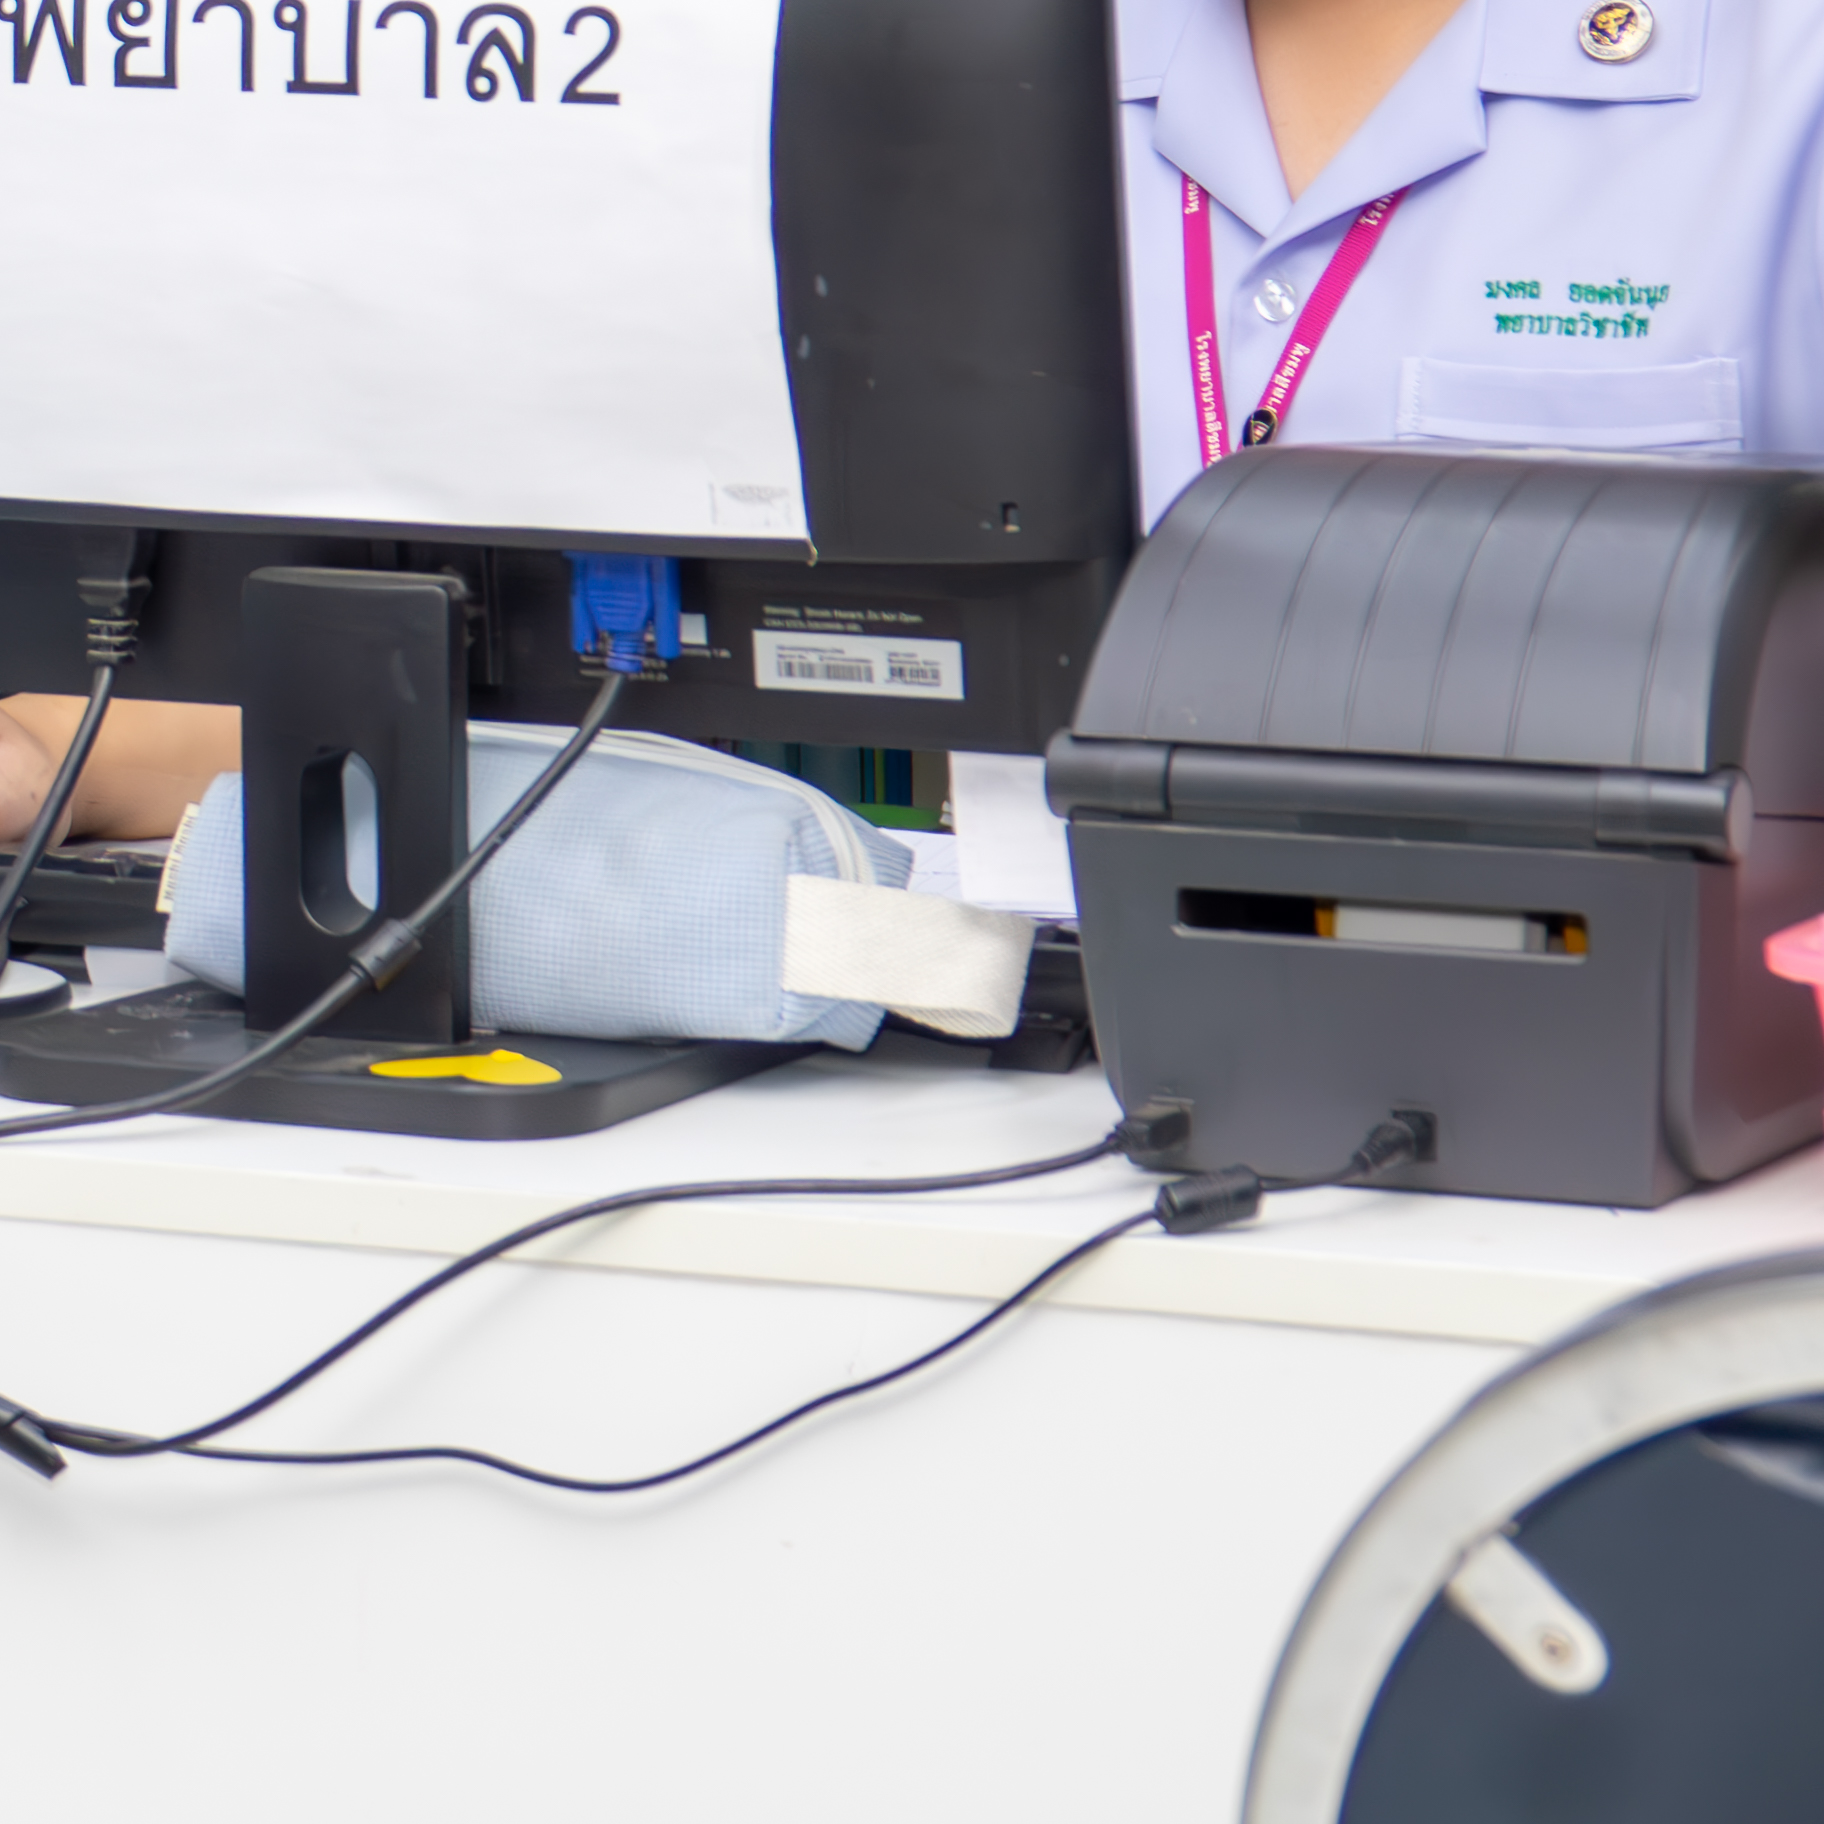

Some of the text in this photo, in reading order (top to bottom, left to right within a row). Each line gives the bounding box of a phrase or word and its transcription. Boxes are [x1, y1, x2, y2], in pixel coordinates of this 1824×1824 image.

[1493, 311, 1651, 339] พยาบาลวิชาชีพ
